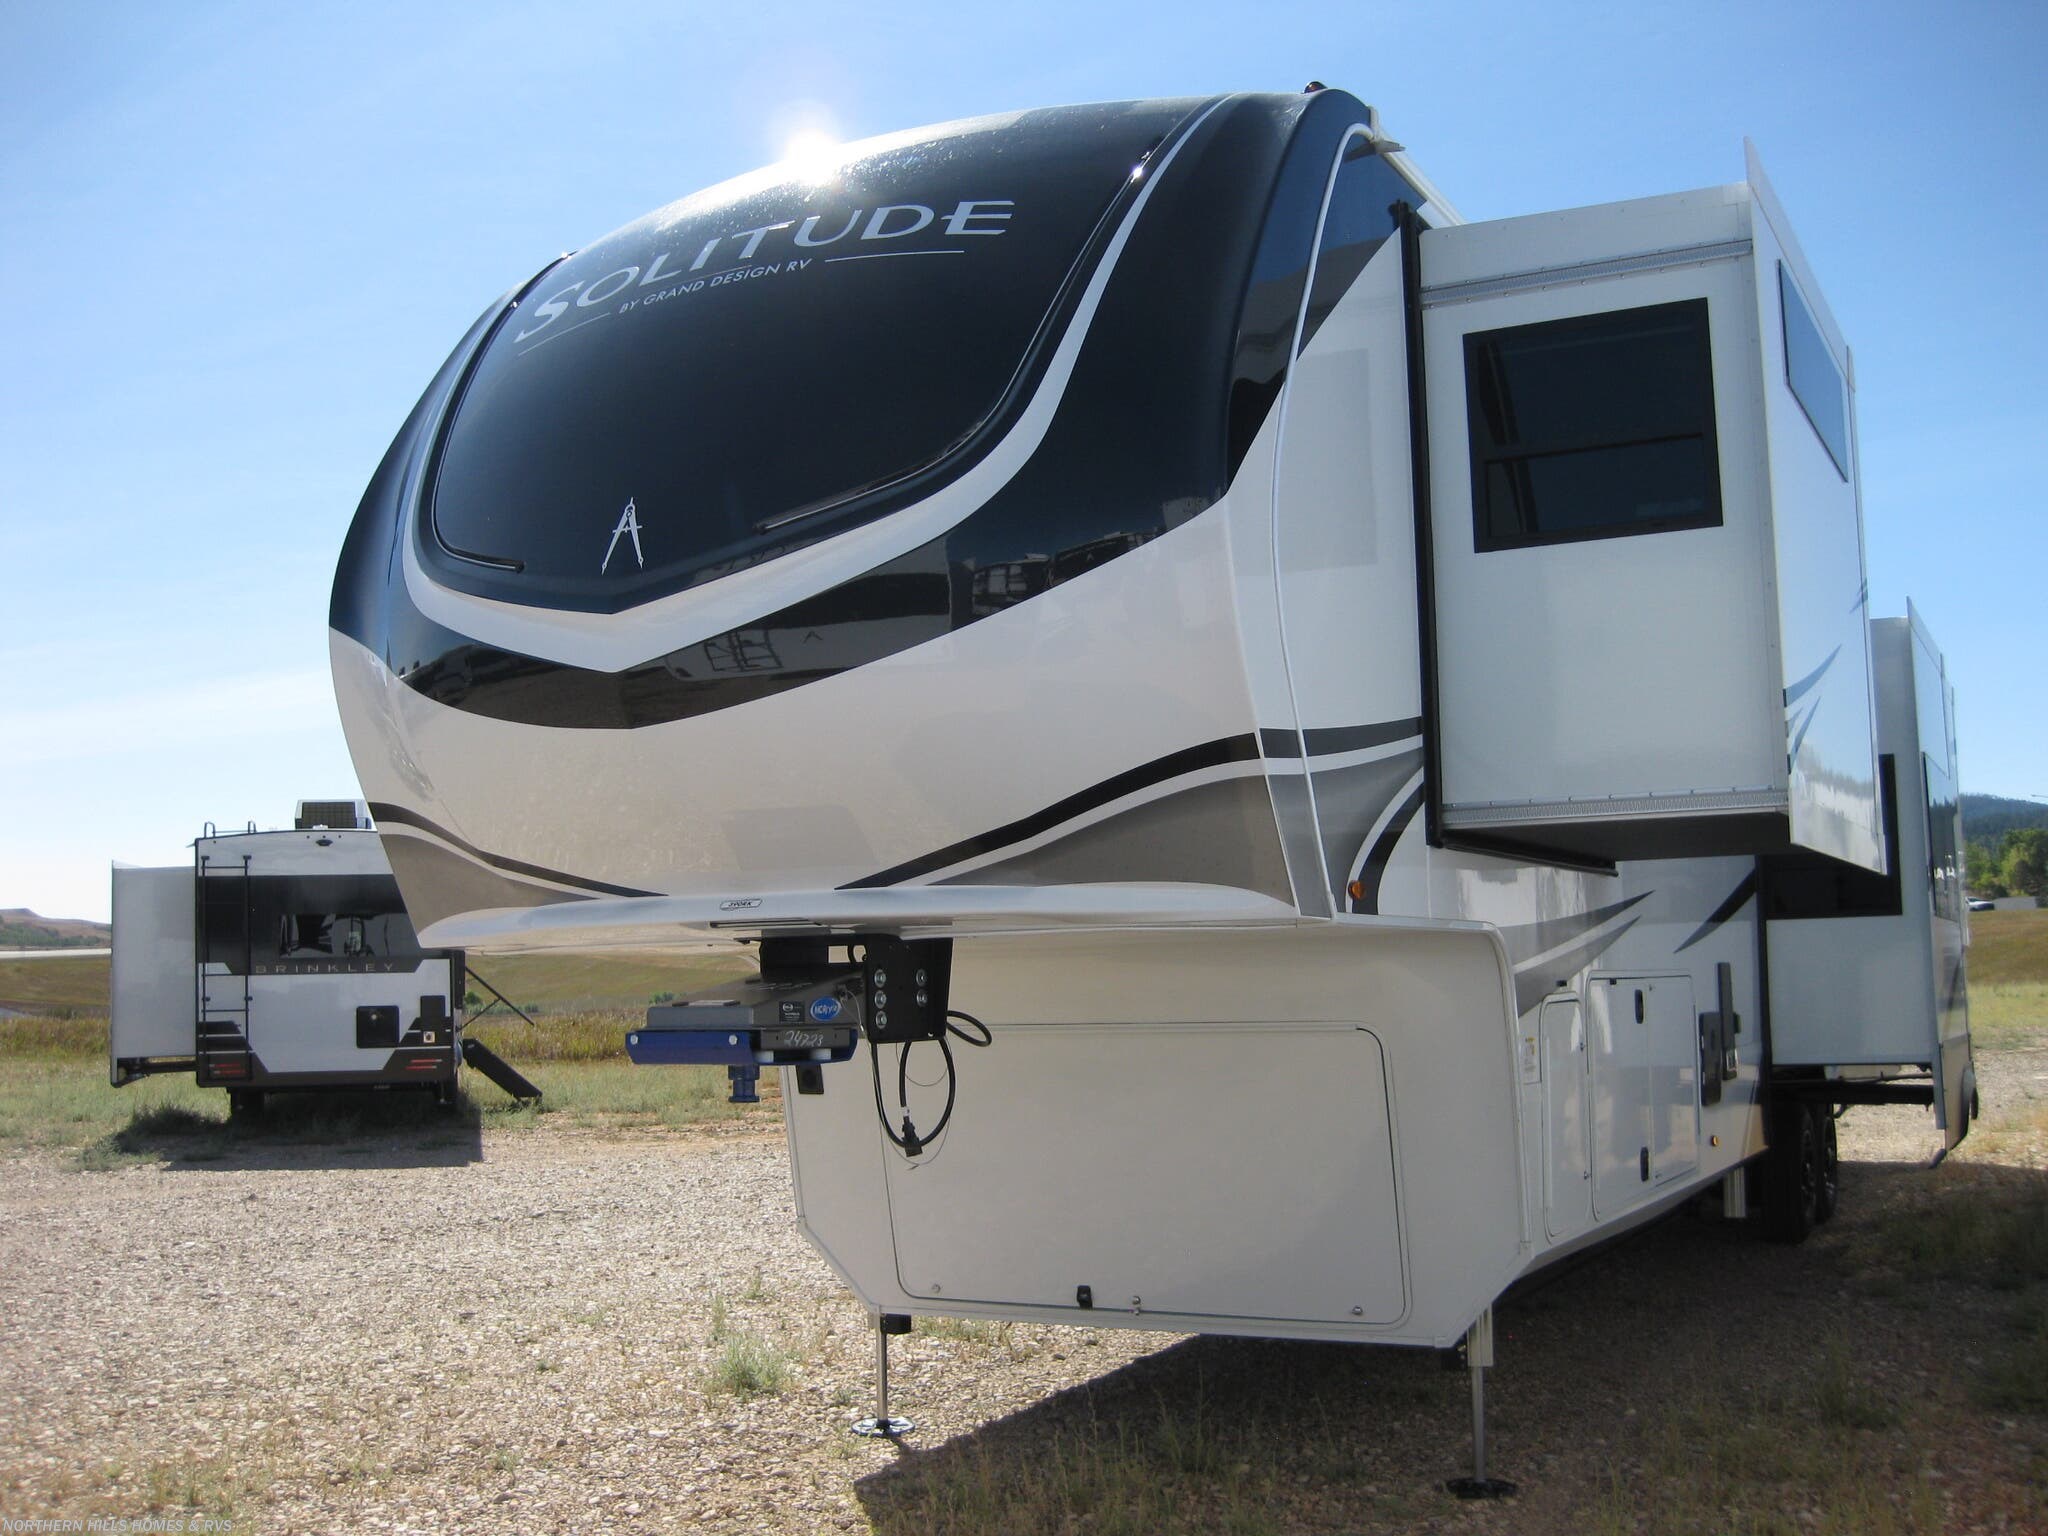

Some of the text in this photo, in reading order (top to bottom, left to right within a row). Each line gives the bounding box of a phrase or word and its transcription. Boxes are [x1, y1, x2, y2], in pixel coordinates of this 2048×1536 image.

[514, 200, 1015, 344] SOLITUDE
[619, 258, 813, 315] BY GRAND DESIGN RV
[255, 963, 394, 974] BRINKLEY
